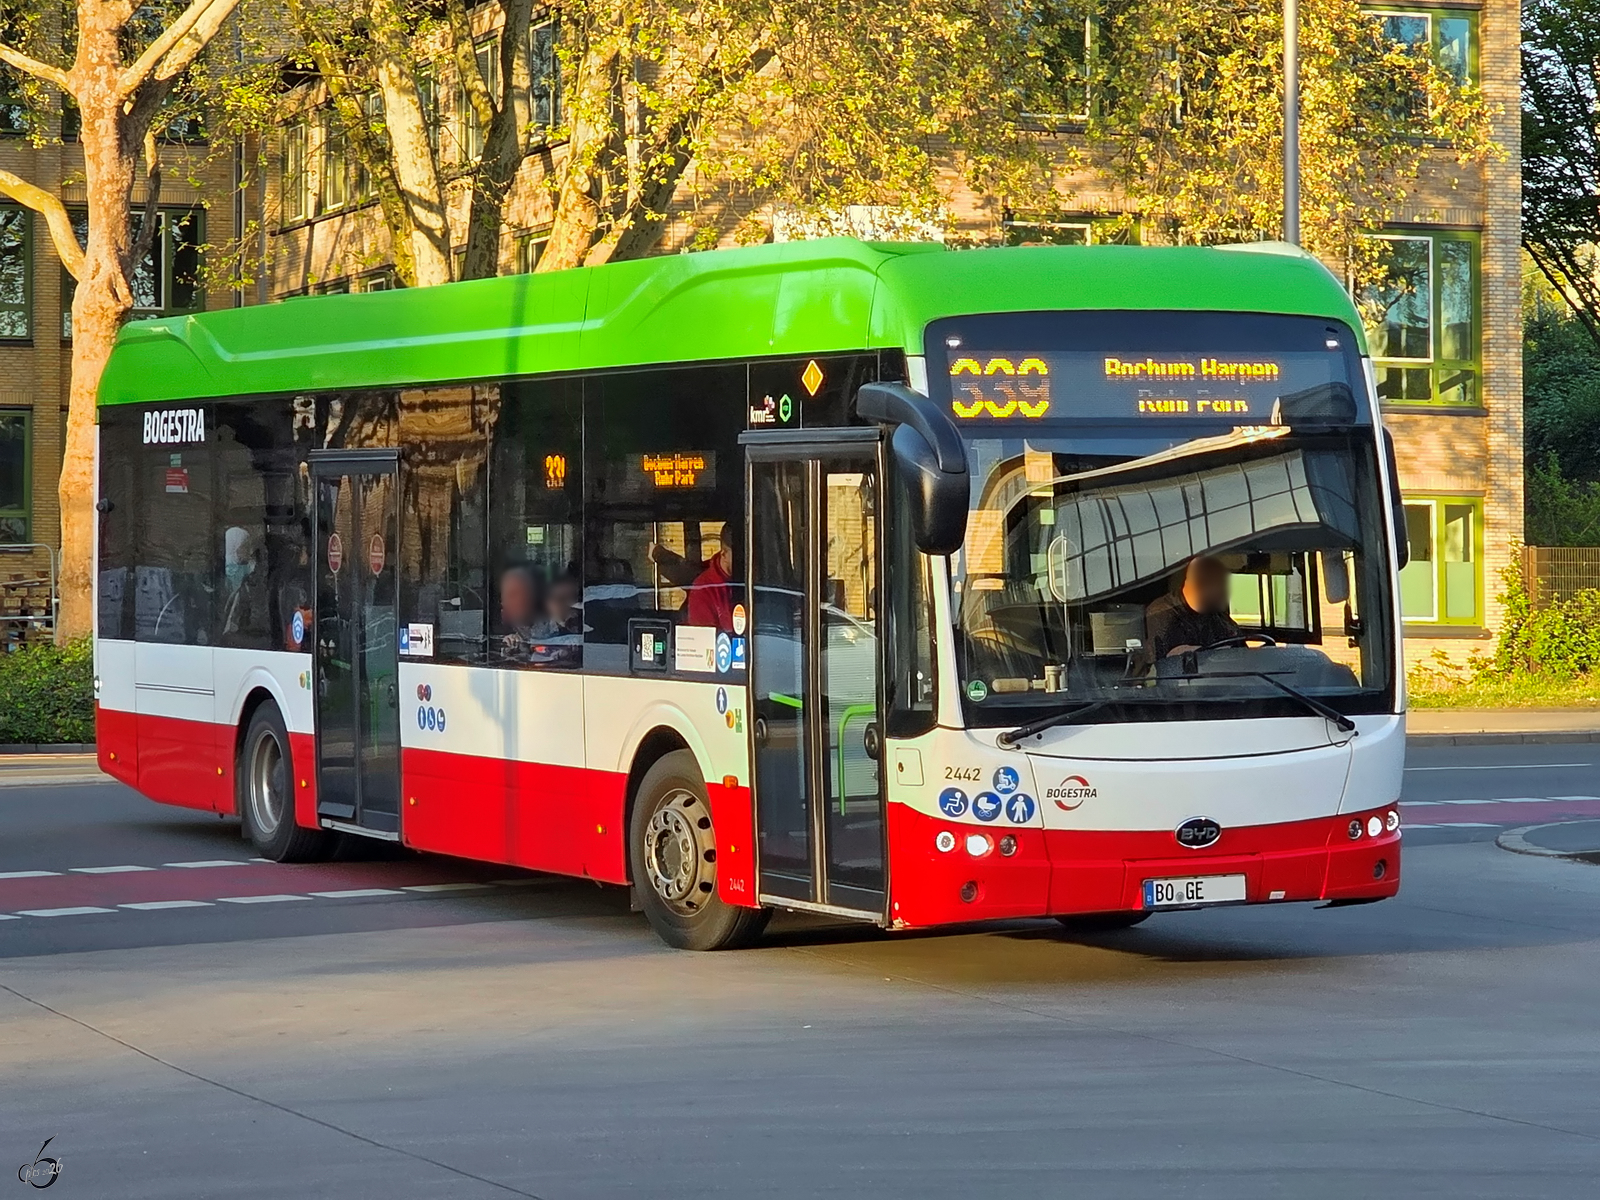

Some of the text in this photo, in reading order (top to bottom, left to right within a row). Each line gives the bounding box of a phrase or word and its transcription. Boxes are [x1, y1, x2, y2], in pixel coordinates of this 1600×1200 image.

[949, 357, 1050, 418] 339
[142, 408, 206, 444] BOGESTRA
[944, 766, 981, 781] 2442
[1046, 787, 1098, 799] BOGESTRA
[1180, 826, 1218, 840] BYD
[729, 877, 745, 893] 2442
[1155, 883, 1174, 902] BO
[1185, 881, 1204, 900] GE
